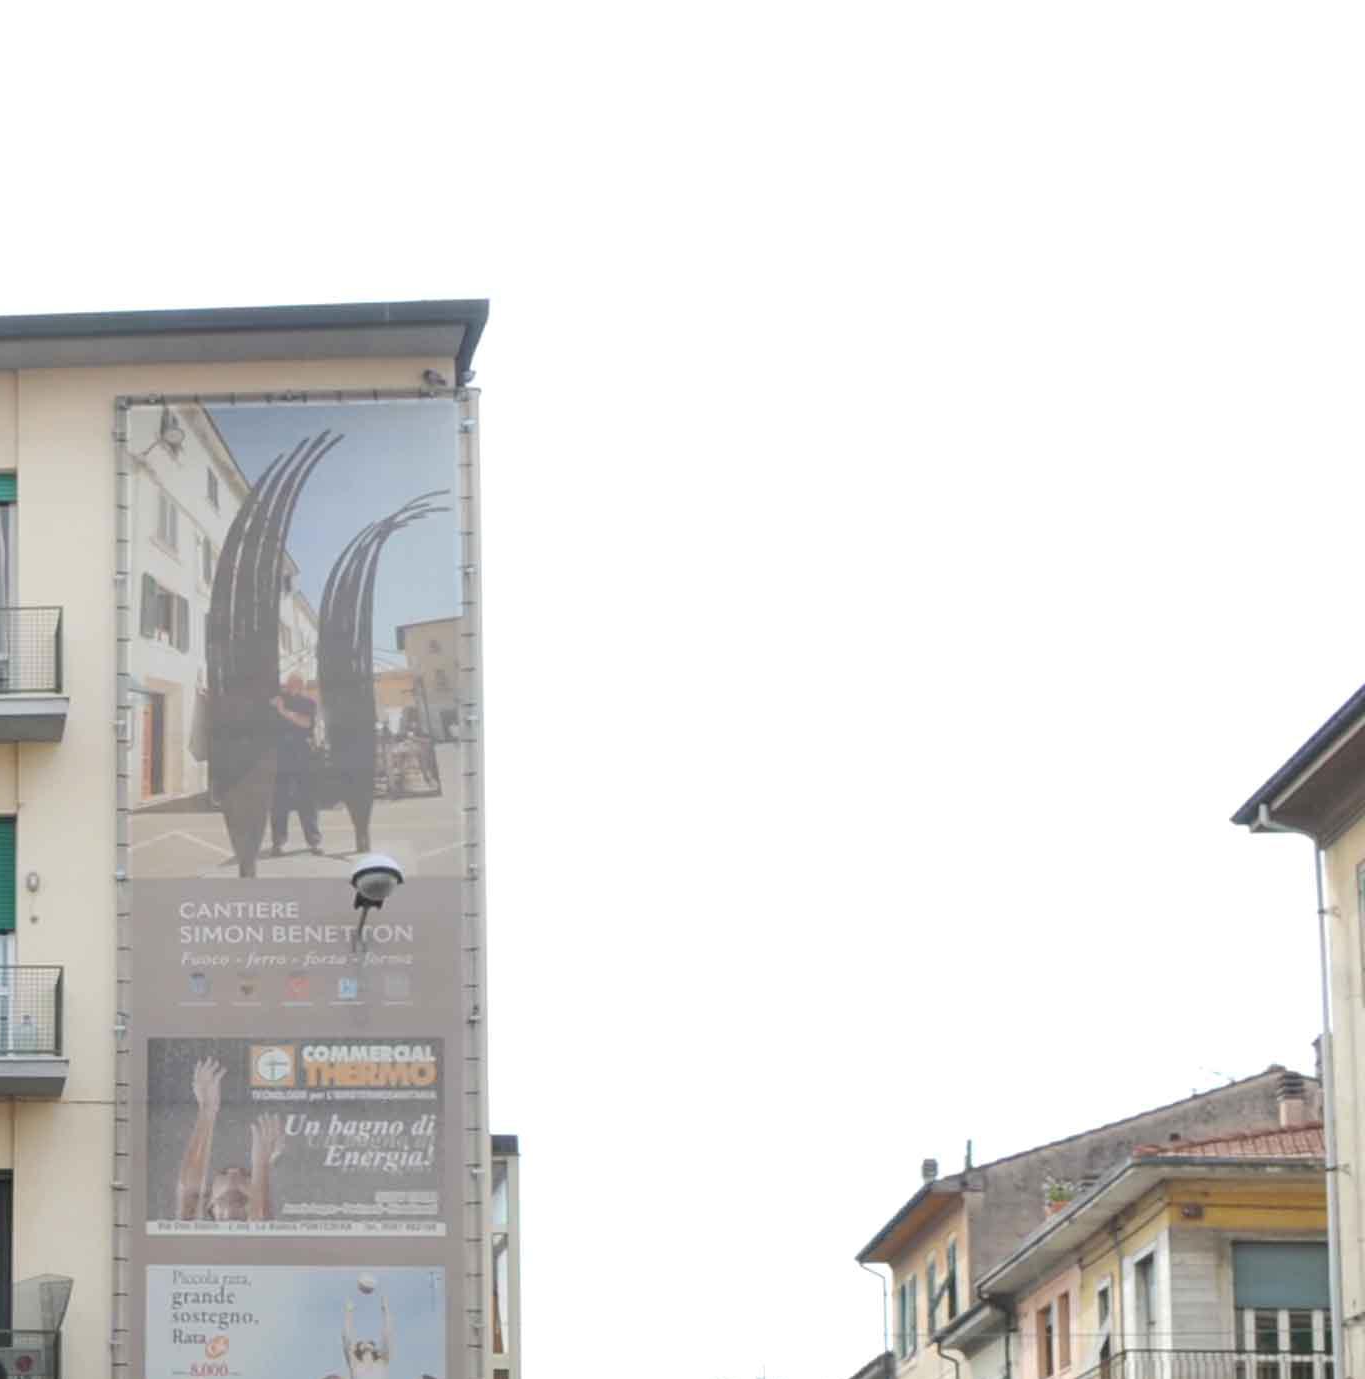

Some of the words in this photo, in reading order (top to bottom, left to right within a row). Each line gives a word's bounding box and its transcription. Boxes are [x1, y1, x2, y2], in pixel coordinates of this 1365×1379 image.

[179, 902, 299, 919] CANTIERE
[180, 925, 263, 943] SIMON
[271, 925, 414, 943] BENETTON
[285, 1114, 320, 1136] Un
[328, 1114, 404, 1143] bagno
[411, 1114, 437, 1136] di
[324, 1145, 435, 1171] Energia!
[172, 1269, 219, 1285] Piccola
[171, 1286, 235, 1309] grande
